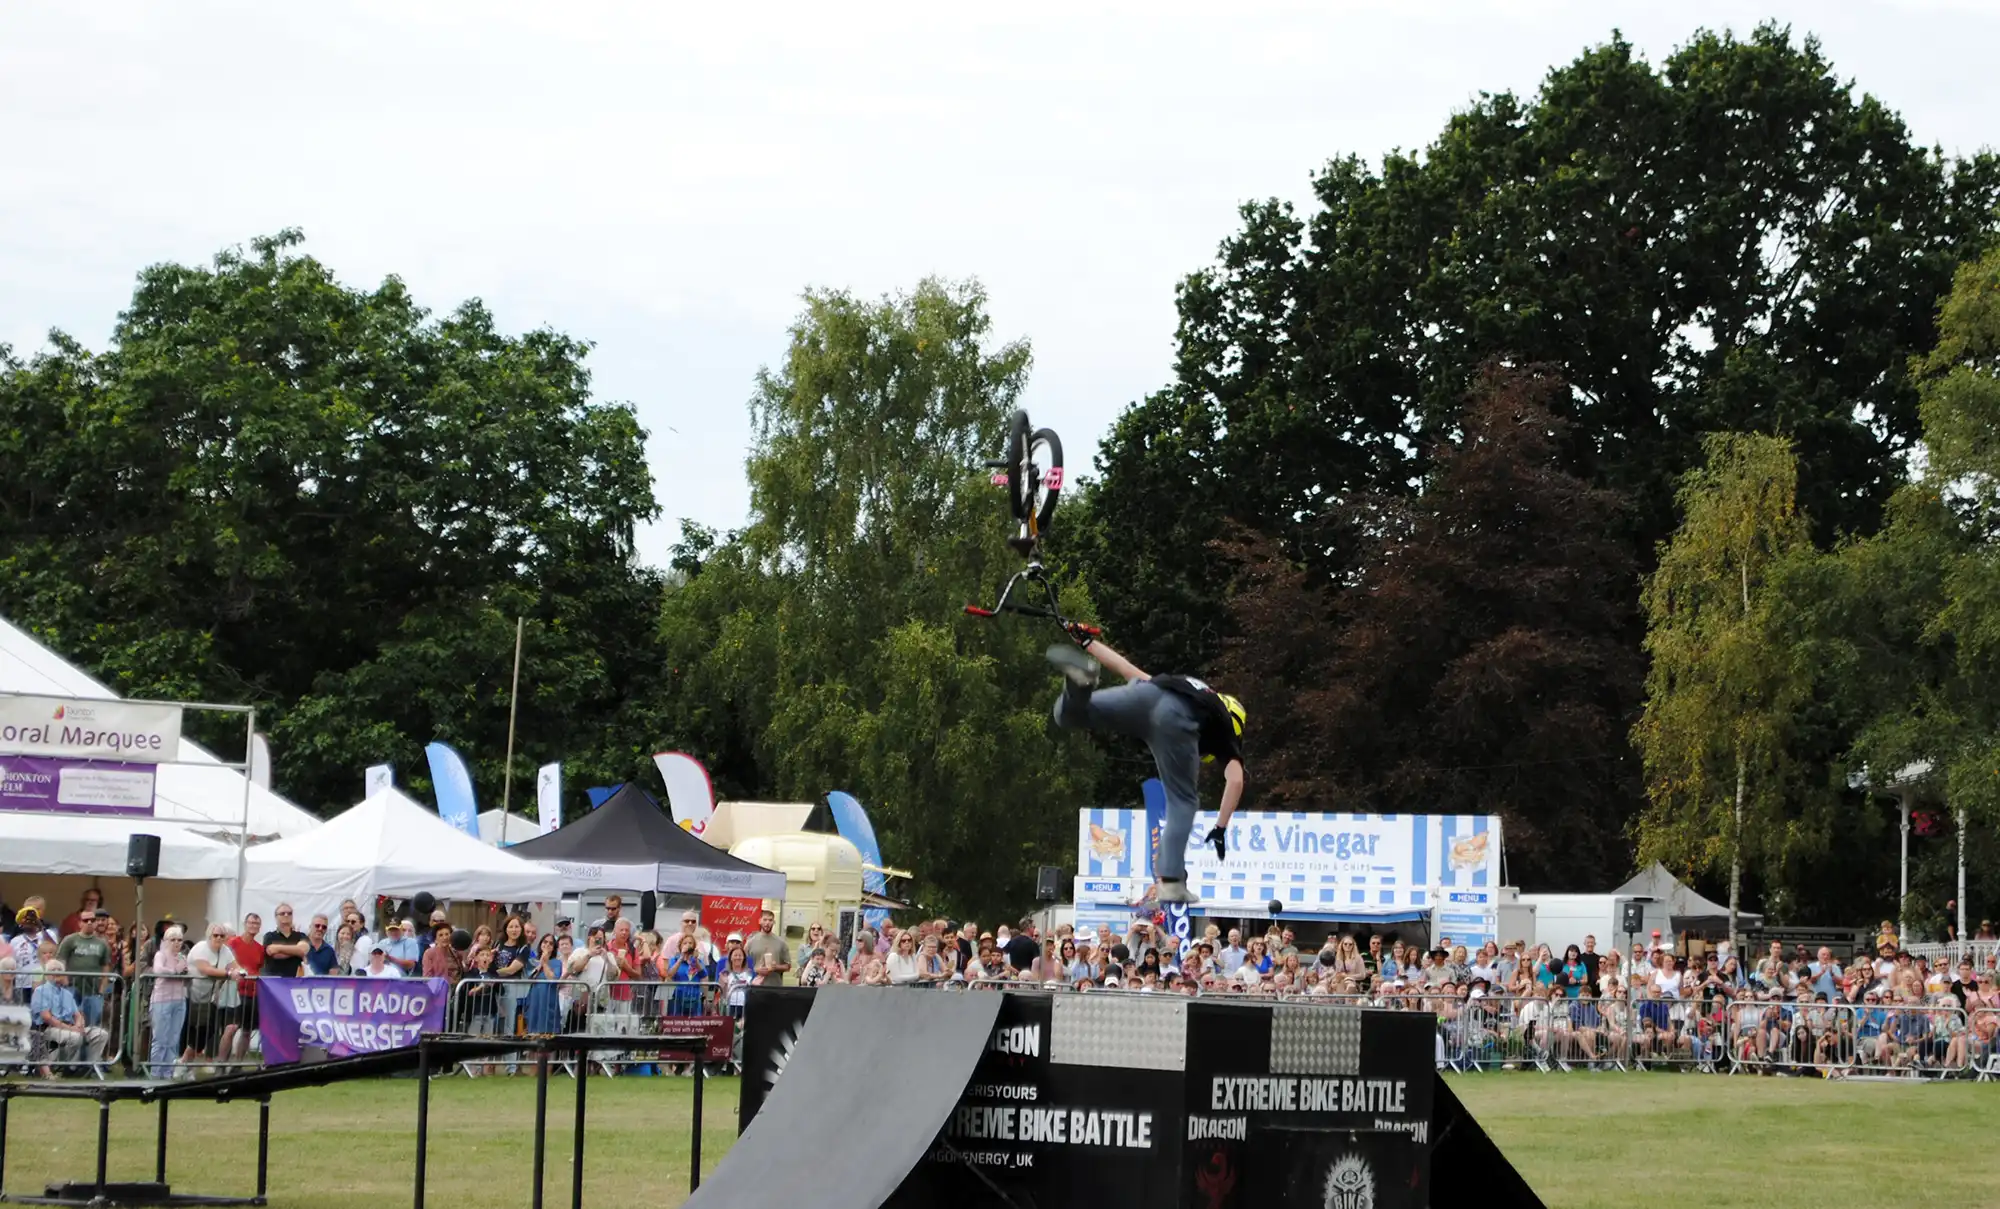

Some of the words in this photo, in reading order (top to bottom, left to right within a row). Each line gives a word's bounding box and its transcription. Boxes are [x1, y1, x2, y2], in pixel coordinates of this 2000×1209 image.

[0, 724, 50, 744] oral
[60, 726, 162, 751] Marquee
[1249, 824, 1267, 852] &
[1274, 825, 1381, 860] Vinegar
[1263, 861, 1304, 870] SOURCED
[1309, 862, 1329, 871] FISH
[1344, 863, 1371, 872] CHIPS
[1458, 894, 1480, 902] MENU
[291, 988, 354, 1016] BBC
[359, 992, 427, 1017] RADIO
[298, 1018, 423, 1050] SOMERSET
[991, 1024, 1040, 1058] GON
[1211, 1077, 1297, 1111] EXTREME
[1300, 1079, 1339, 1112] BIKE
[1341, 1080, 1406, 1113] BATTLE
[1019, 1108, 1067, 1144] BIKE
[1070, 1110, 1152, 1149] BATTLE
[1188, 1115, 1247, 1142] DRAGON
